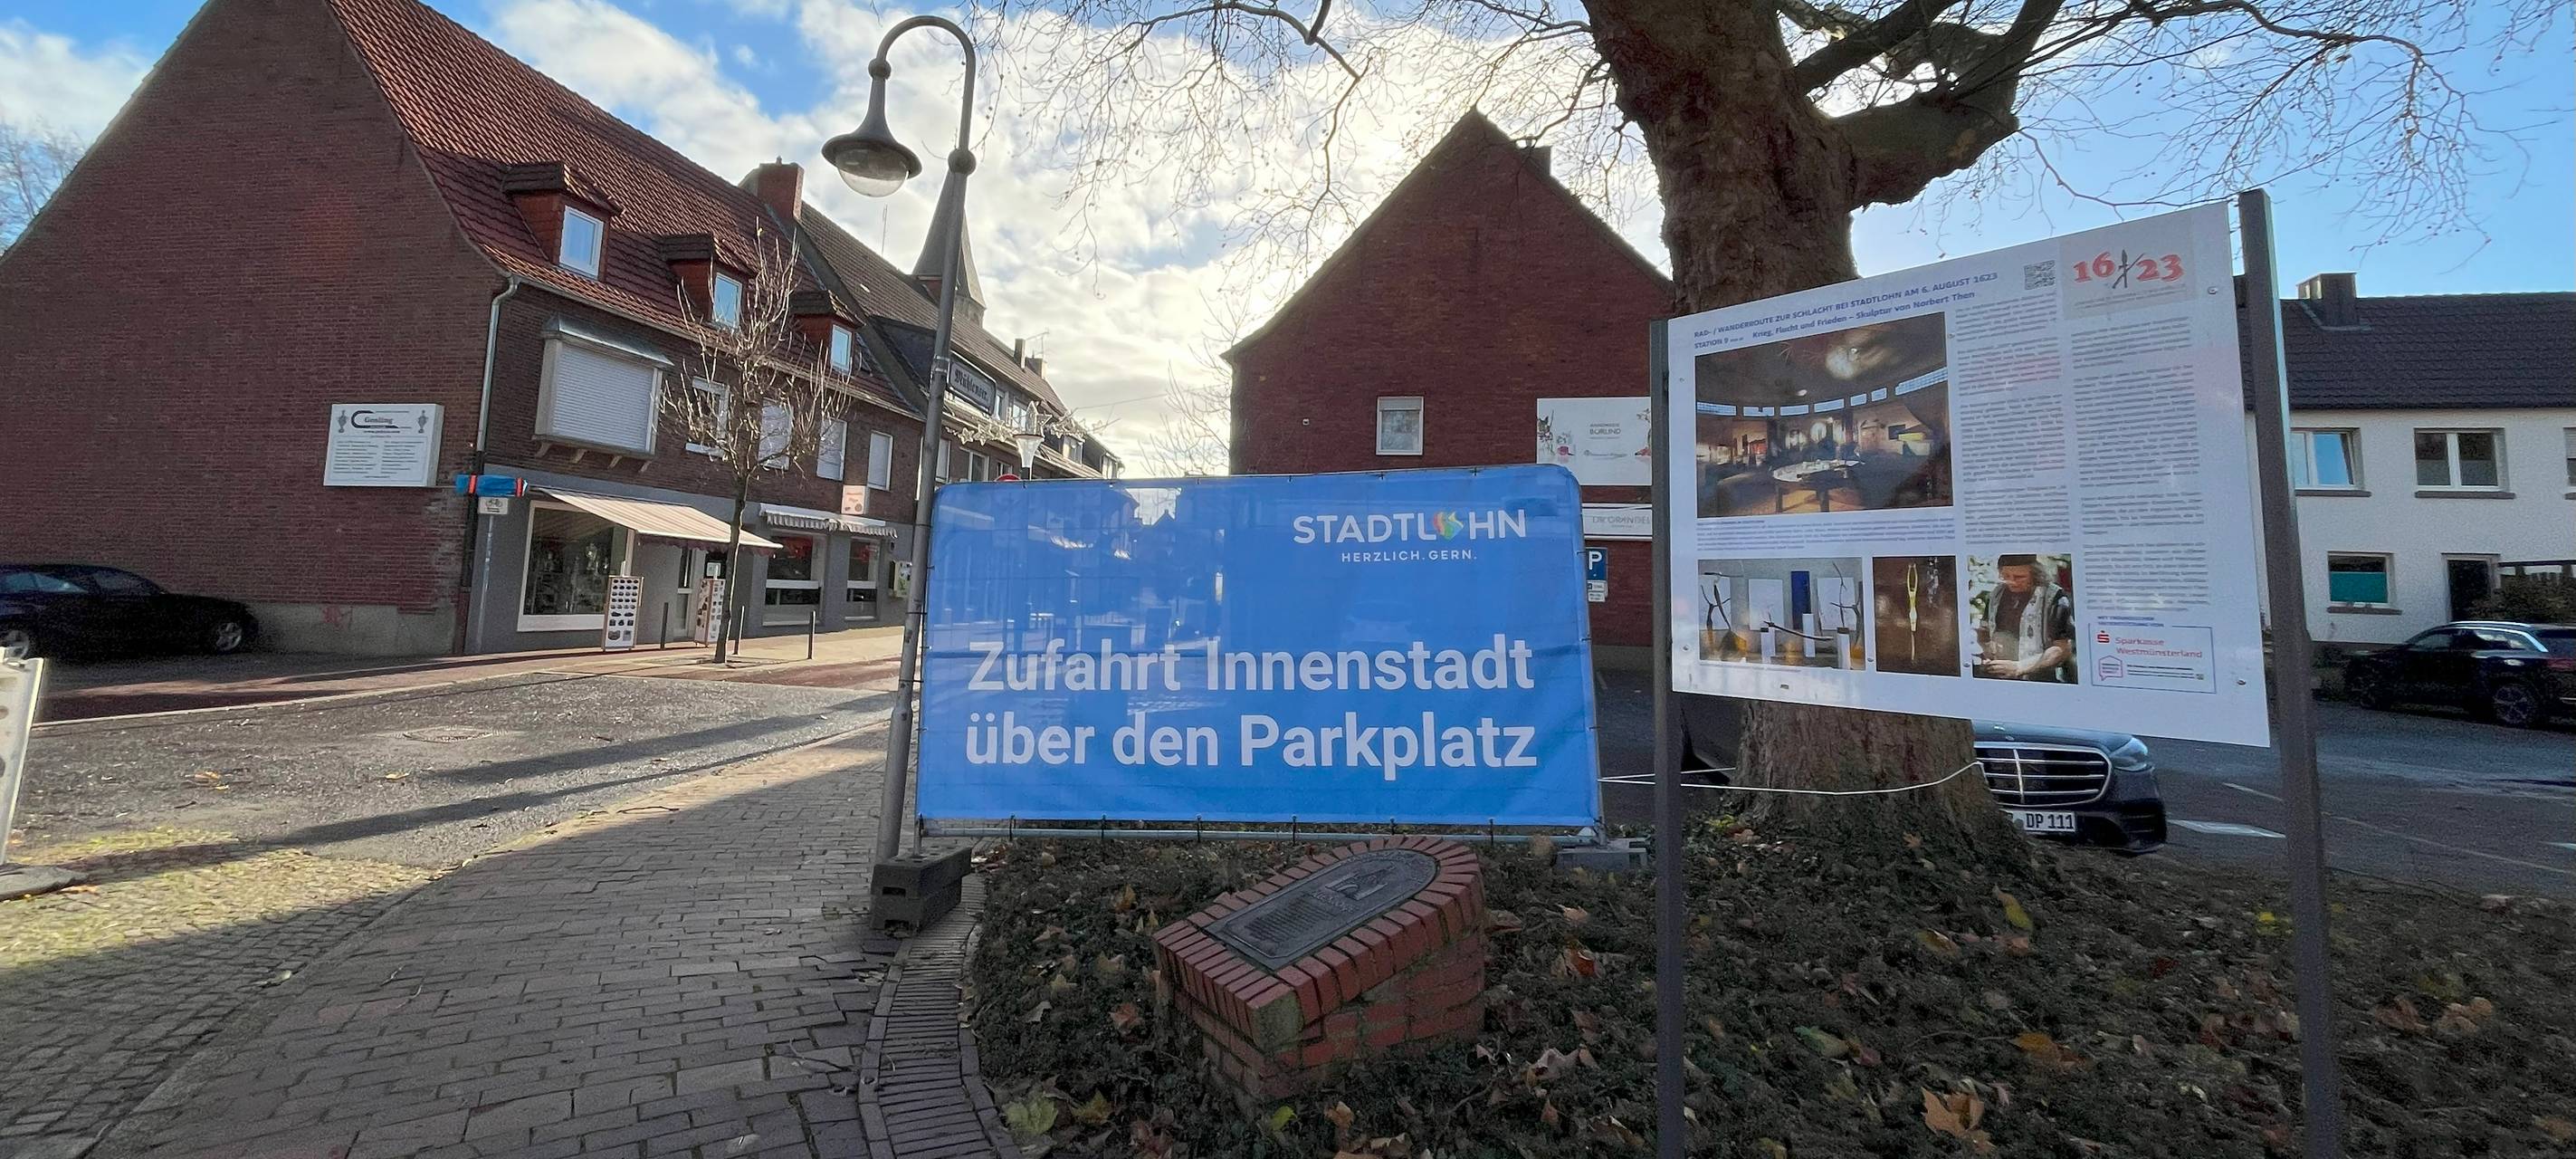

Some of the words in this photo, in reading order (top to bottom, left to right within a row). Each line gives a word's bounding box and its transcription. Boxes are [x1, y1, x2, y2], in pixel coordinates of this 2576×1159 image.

[1693, 330, 1711, 339] RAD-
[1718, 316, 1774, 333] WANDERROUTE
[1775, 313, 1790, 322] ZUR
[1792, 304, 1834, 319] SCHLACHT
[1835, 302, 1849, 311] BEI
[1850, 292, 1902, 308] STADTLOHN
[1903, 288, 1919, 298] AM
[1932, 277, 1970, 292] AUGUST
[1973, 272, 1998, 283] 1623
[1693, 338, 1722, 350] STATION
[1775, 323, 1798, 334] Flucht
[1800, 321, 1816, 330] und
[1817, 315, 1847, 326] Frieden
[1856, 306, 1892, 320] Skulptur
[1894, 303, 1911, 311] von
[1913, 295, 1949, 309] Norbert
[1951, 292, 1975, 302] Then
[1589, 551, 1603, 570] P
[2115, 637, 2164, 646] Sparkasse
[2116, 647, 2202, 658] Westmünsterland
[967, 637, 1182, 692] Zufahrt
[1206, 634, 1535, 692] Innenstadt
[966, 713, 1094, 765] über
[1113, 713, 1218, 767] den
[1240, 712, 1537, 781] Parkplatz
[2027, 812, 2044, 829] DP
[2047, 813, 2075, 829] 111
